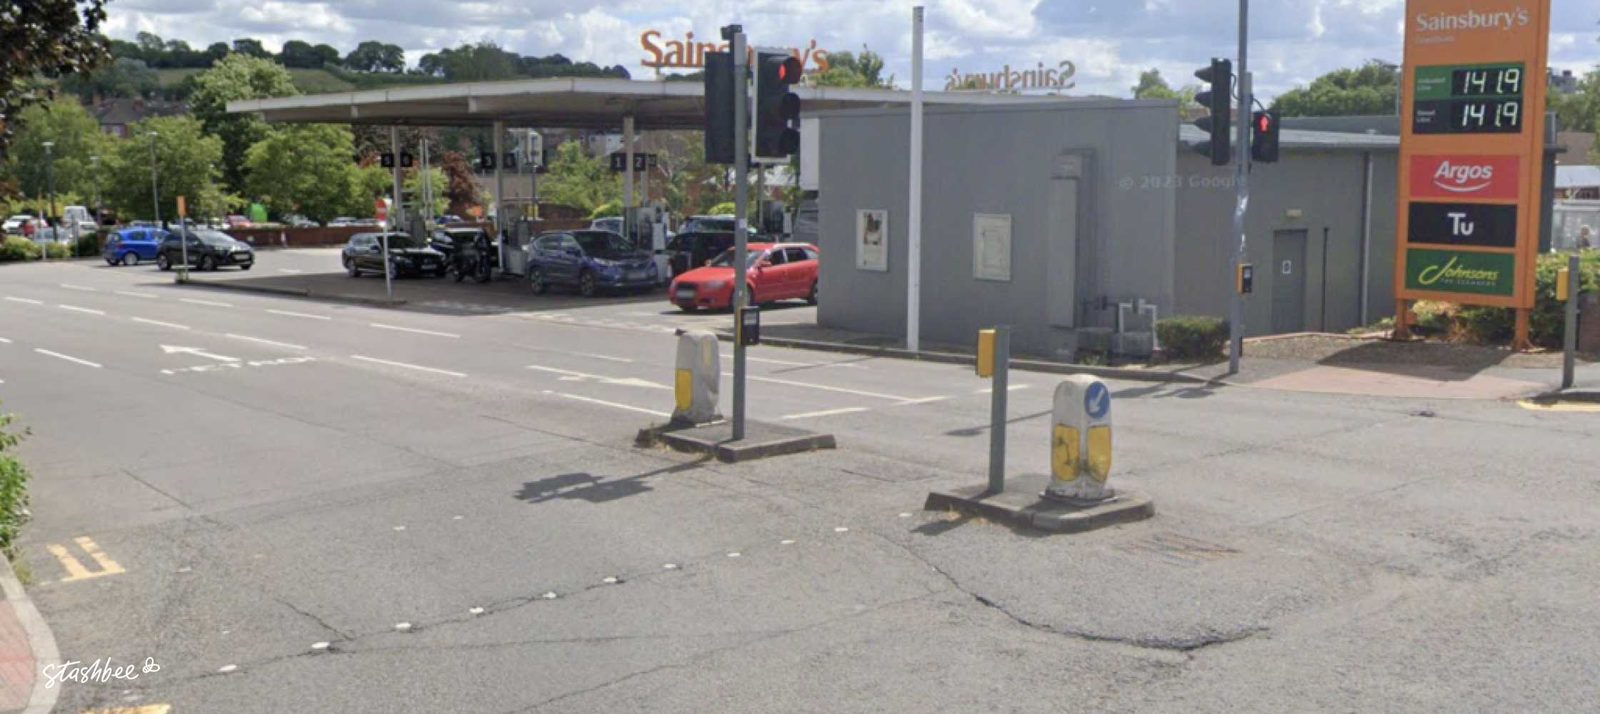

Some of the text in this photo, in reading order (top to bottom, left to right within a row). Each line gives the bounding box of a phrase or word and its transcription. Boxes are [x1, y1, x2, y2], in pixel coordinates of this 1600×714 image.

[1416, 6, 1529, 32] Sainsbury's
[1434, 160, 1493, 184] Argos
[1447, 212, 1474, 235] Tu
[1419, 256, 1499, 285] Johnsons
